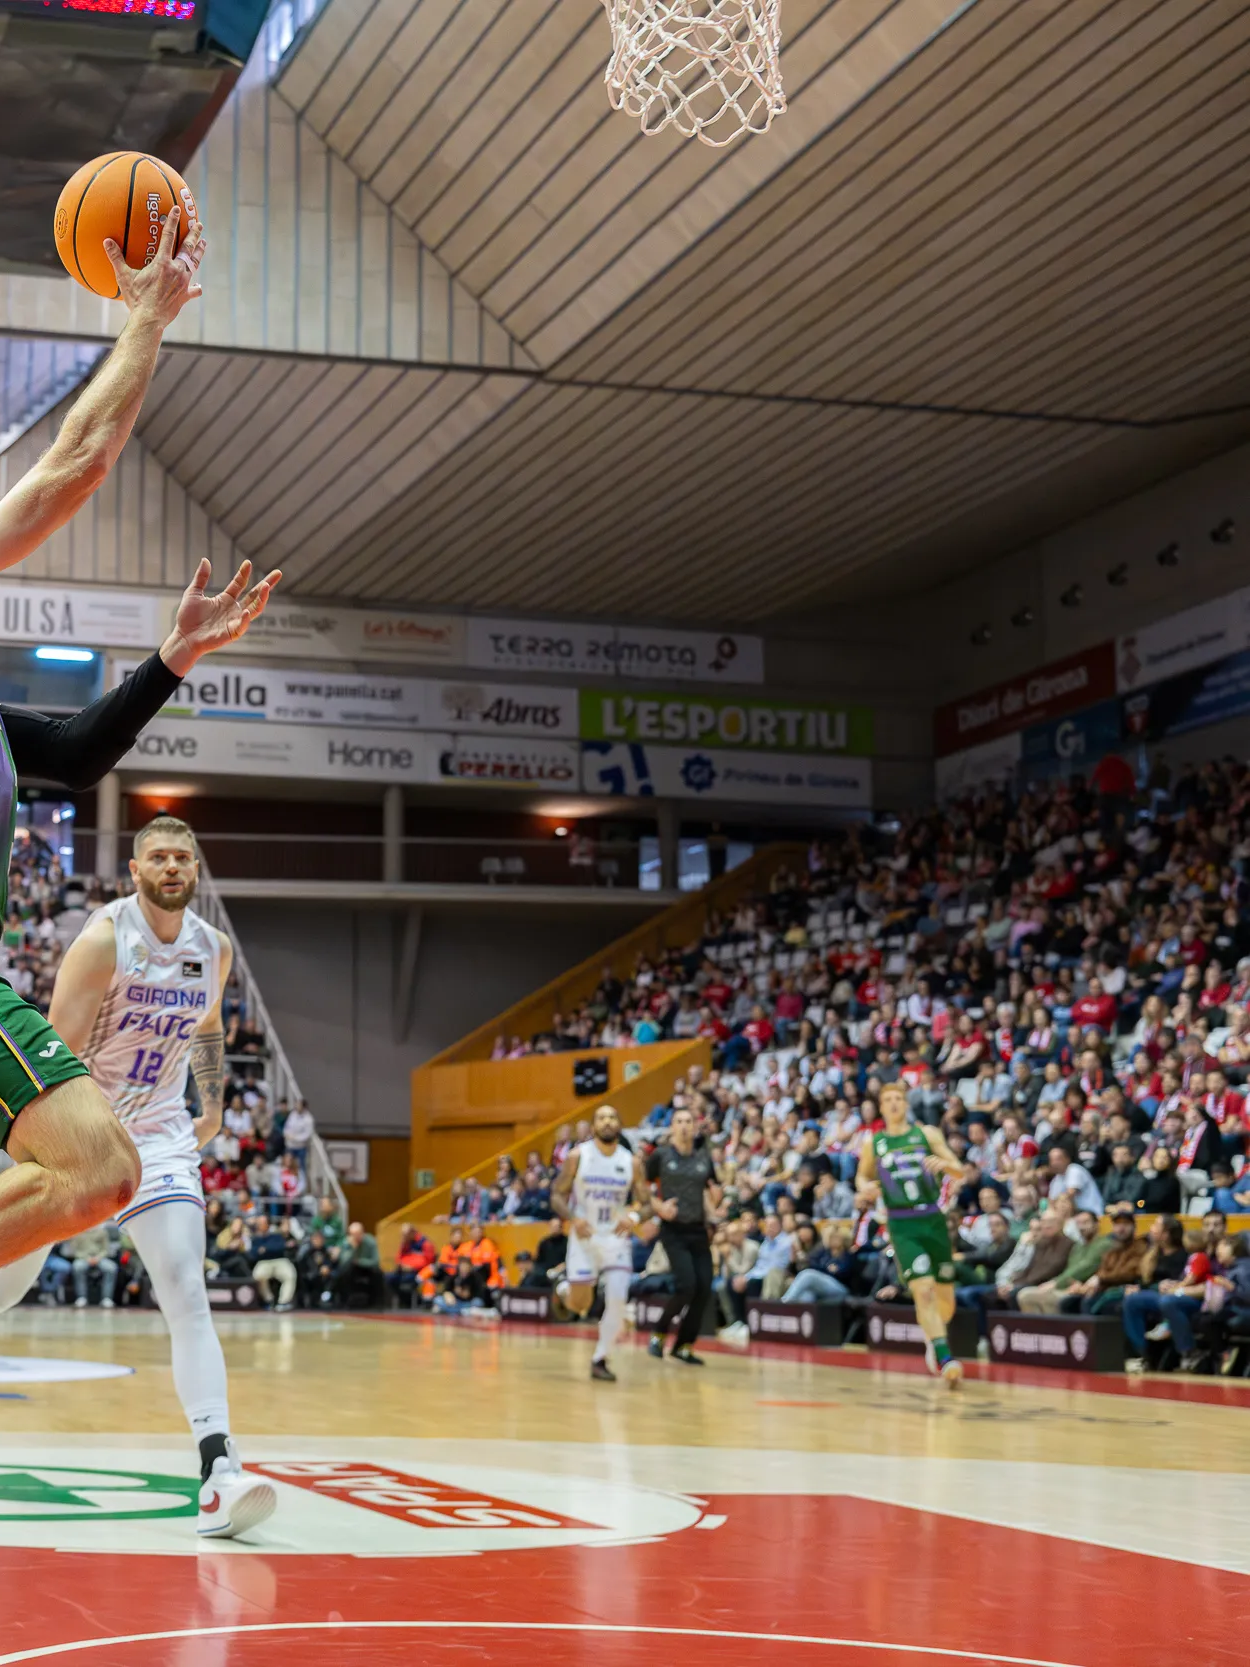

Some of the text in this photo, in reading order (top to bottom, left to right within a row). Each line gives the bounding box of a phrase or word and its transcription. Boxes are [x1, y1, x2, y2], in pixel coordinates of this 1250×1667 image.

[144, 193, 161, 266] liga ende
[602, 696, 847, 748] L'ESPORTIU
[328, 741, 413, 769] Home
[127, 985, 207, 1010] GIRONA
[126, 1048, 164, 1085] 12
[258, 1463, 562, 1528] SPAR
